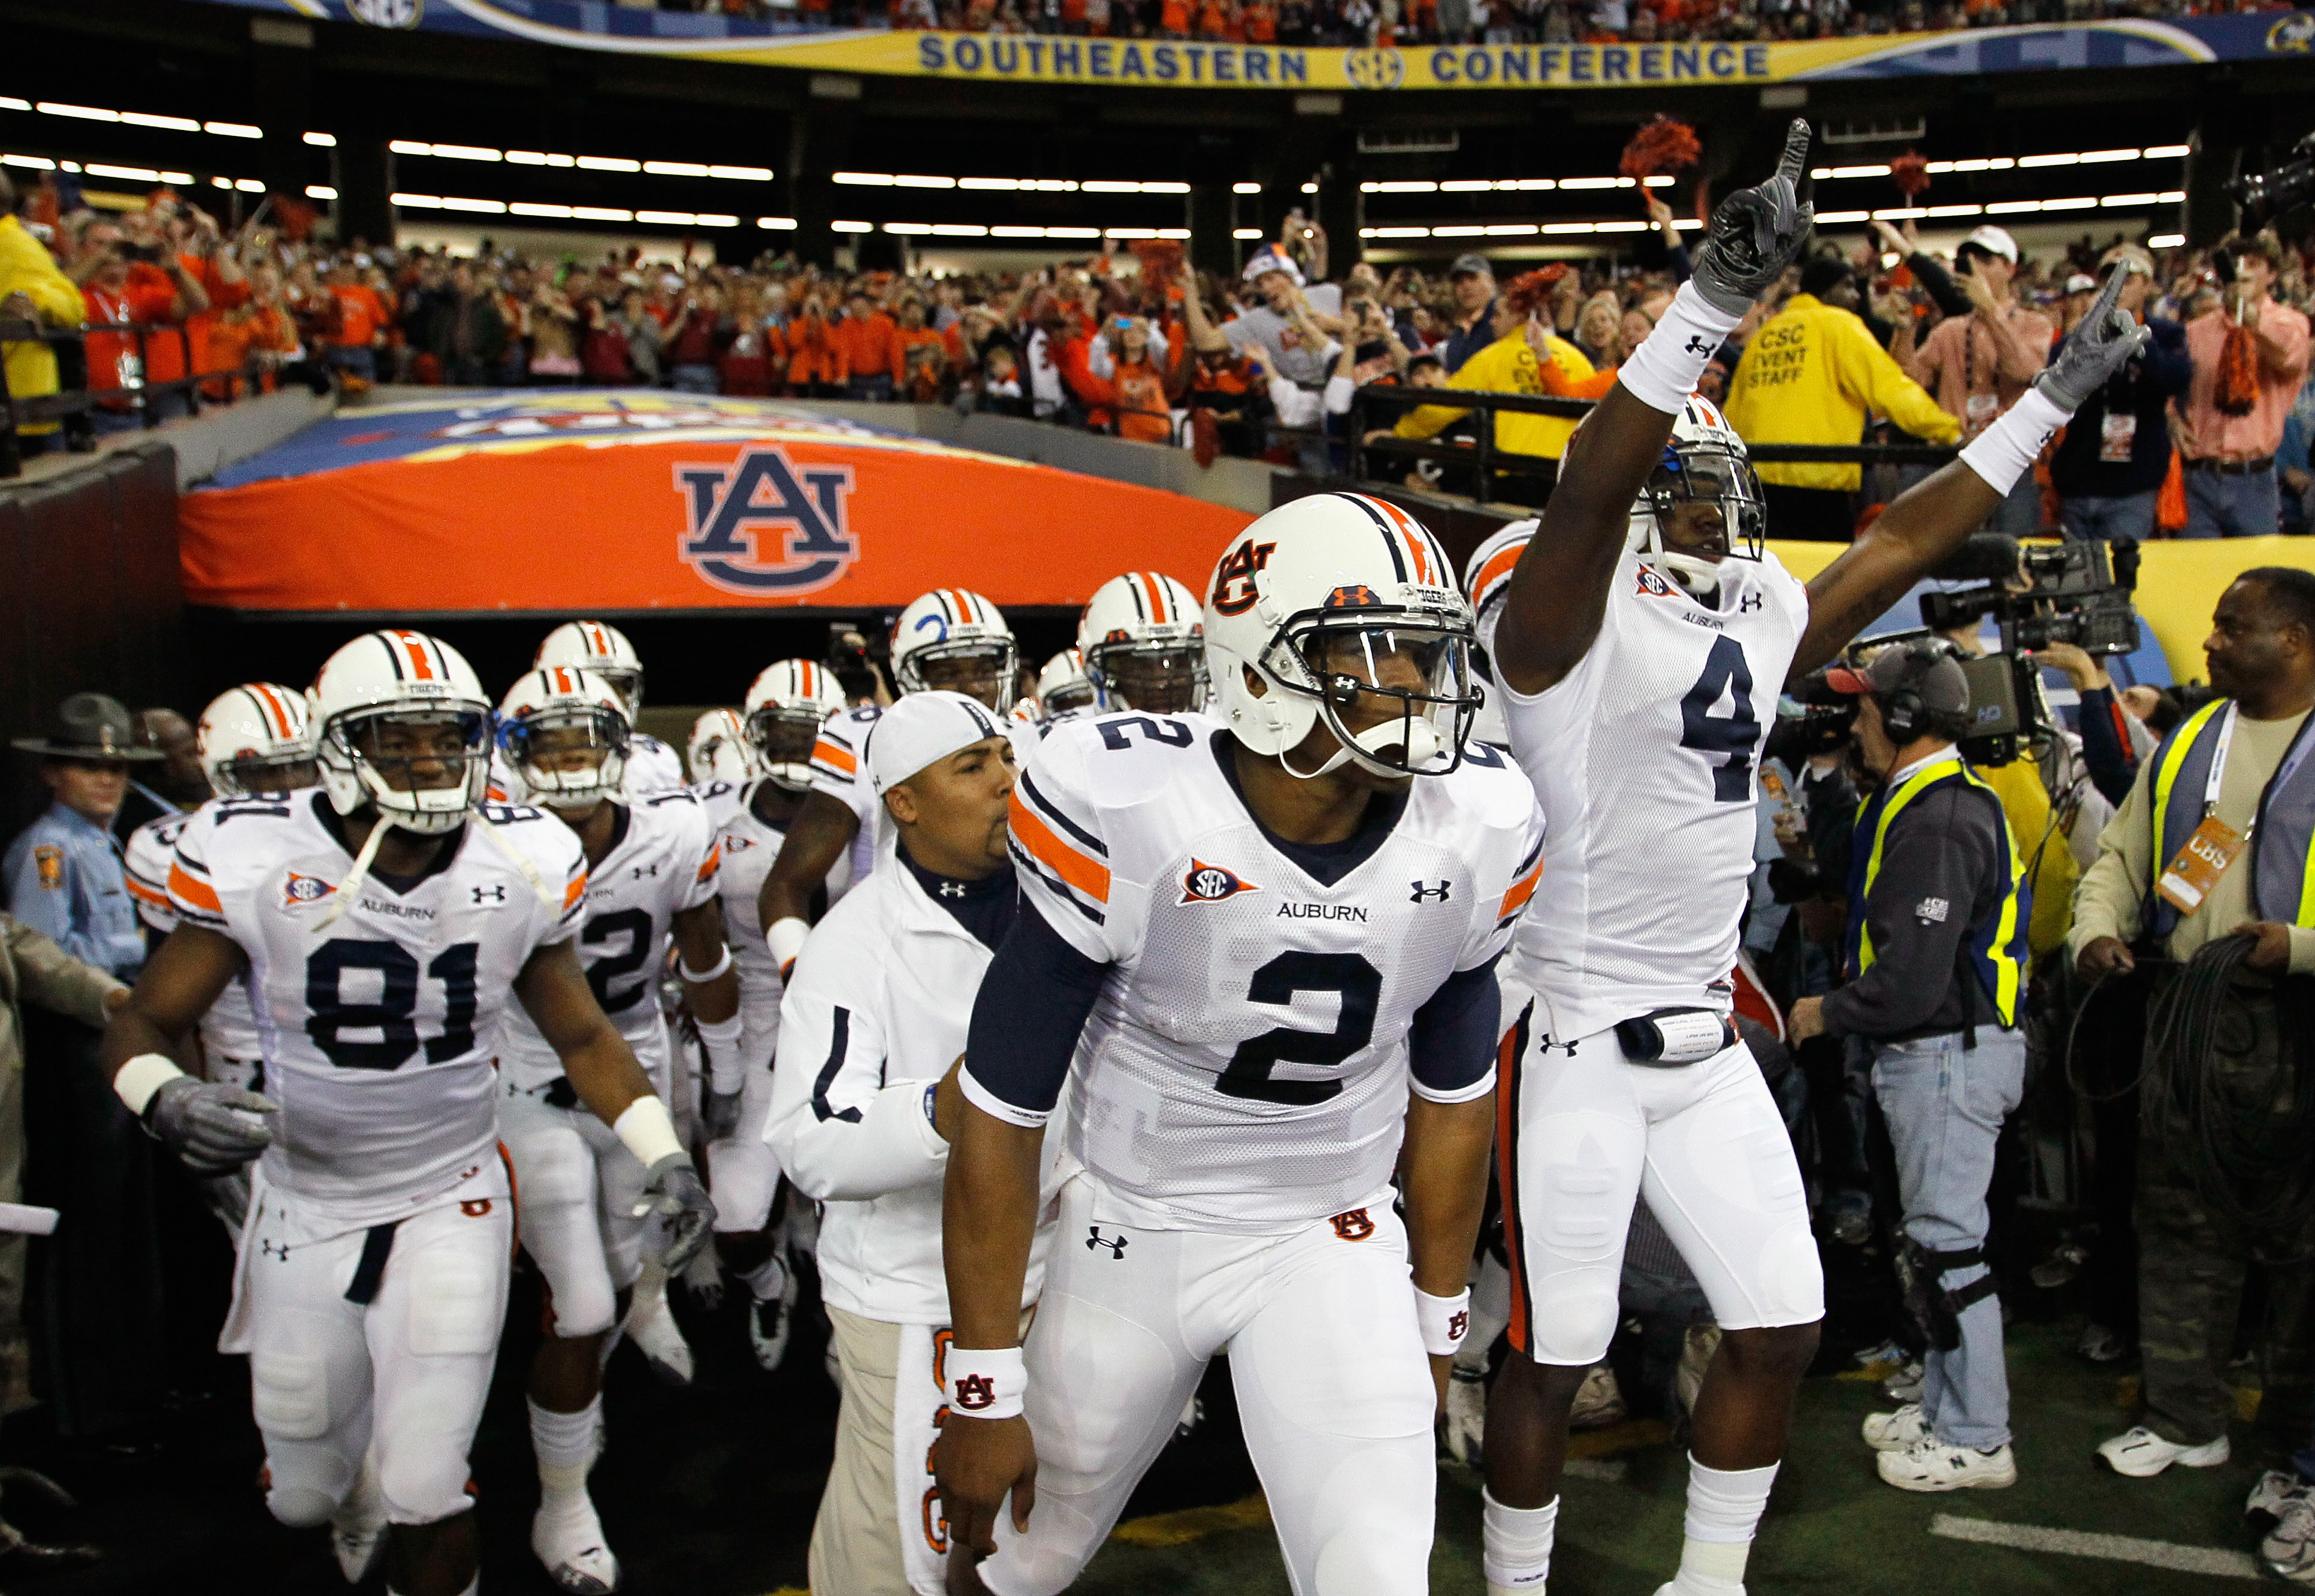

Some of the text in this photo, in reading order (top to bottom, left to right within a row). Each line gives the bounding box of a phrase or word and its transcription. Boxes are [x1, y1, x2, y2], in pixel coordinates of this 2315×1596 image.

[918, 34, 1308, 83] SOUTHEASTERN
[1430, 42, 1769, 83] CONFERENCE
[1760, 324, 1805, 348] CSC
[1755, 346, 1806, 370] EVENT
[1747, 367, 1803, 388] STAFF
[1643, 572, 1663, 594] SEC
[1679, 633, 1762, 802] 4
[1095, 717, 1194, 750] 2
[2189, 835, 2227, 869] CBS
[1195, 869, 1227, 898] SEC
[361, 899, 437, 920] AUBURN
[1277, 903, 1368, 923] AUBURN
[304, 939, 479, 1070] 81
[1214, 950, 1383, 1106] 2
